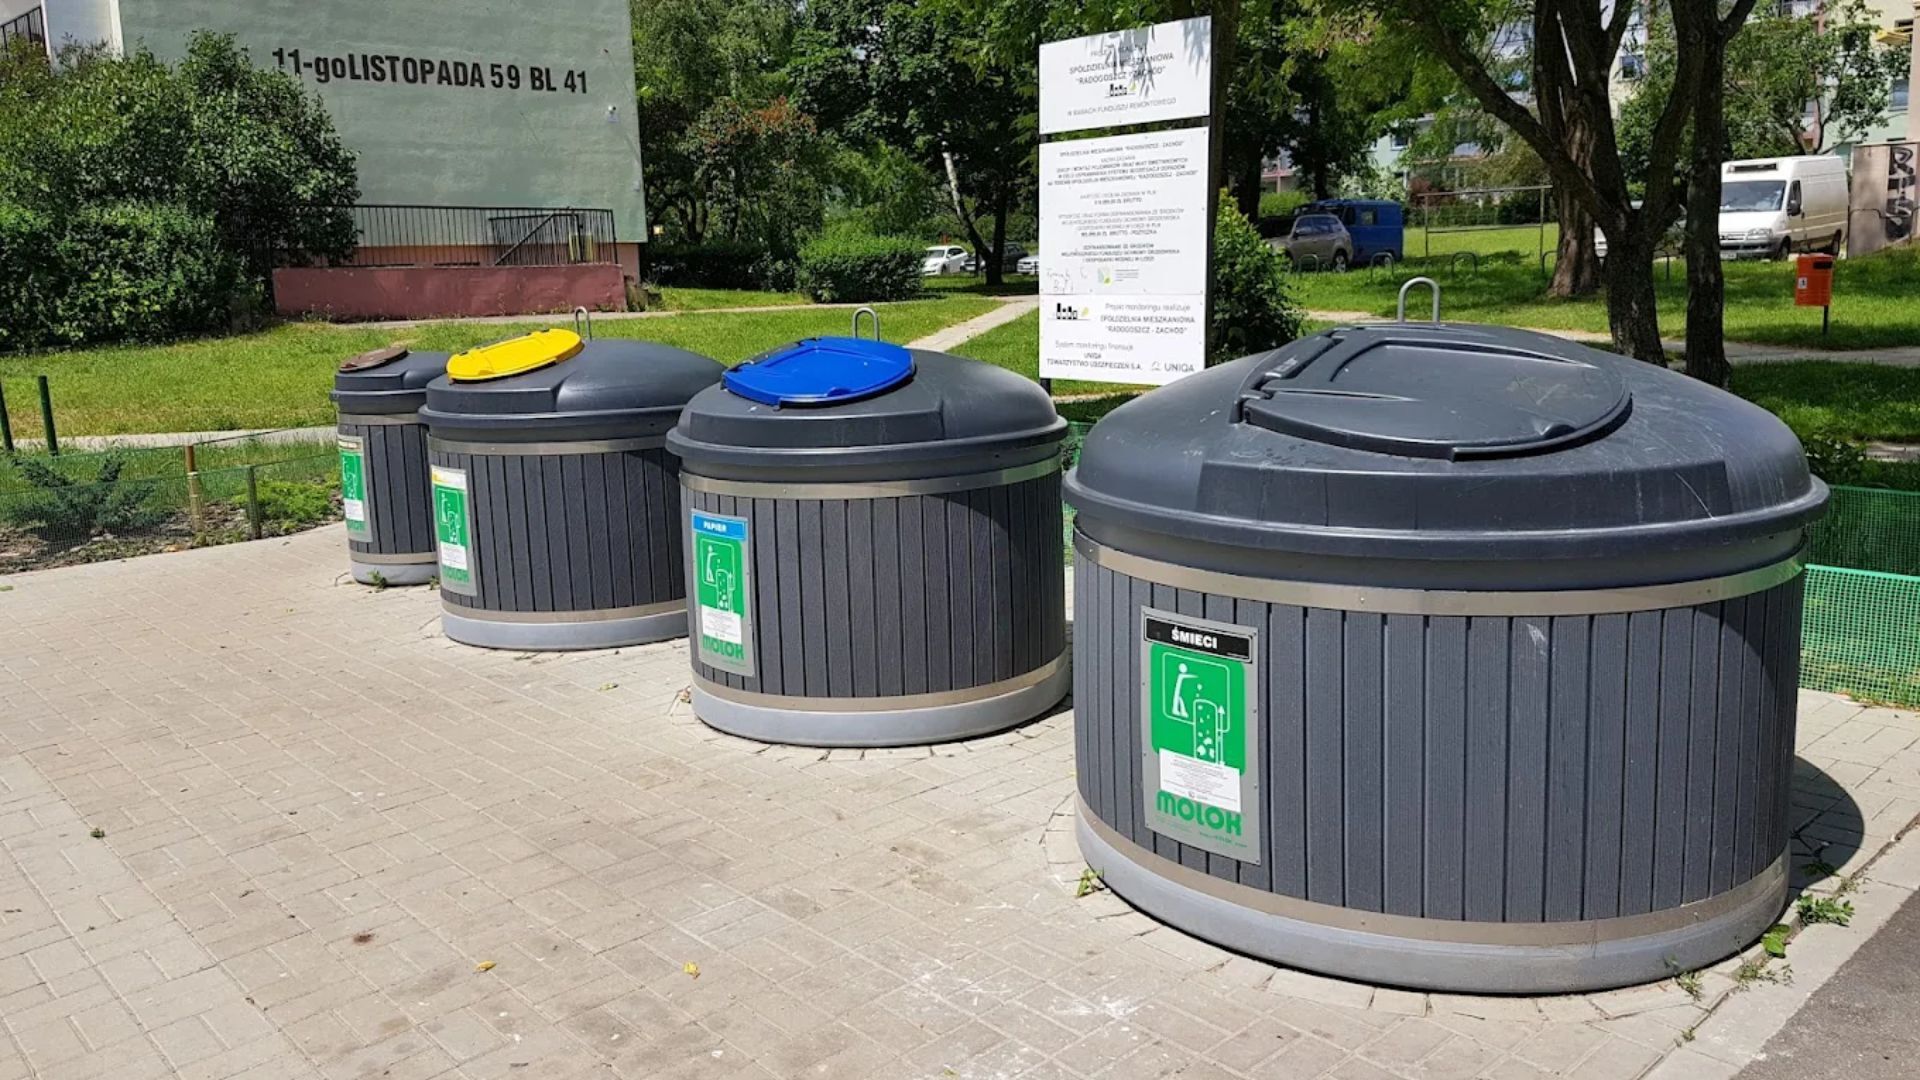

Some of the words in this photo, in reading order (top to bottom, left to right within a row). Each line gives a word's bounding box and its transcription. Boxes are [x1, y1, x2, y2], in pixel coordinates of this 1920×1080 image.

[490, 63, 520, 90] 59
[530, 66, 557, 92] BL
[564, 70, 587, 94] 41
[1143, 315, 1195, 324] MIESZKANIOWA
[1164, 363, 1194, 373] UNIQA
[703, 520, 727, 533] PAPIER
[1171, 626, 1218, 649] ŚMIECI
[1157, 790, 1242, 836] MOLOK
